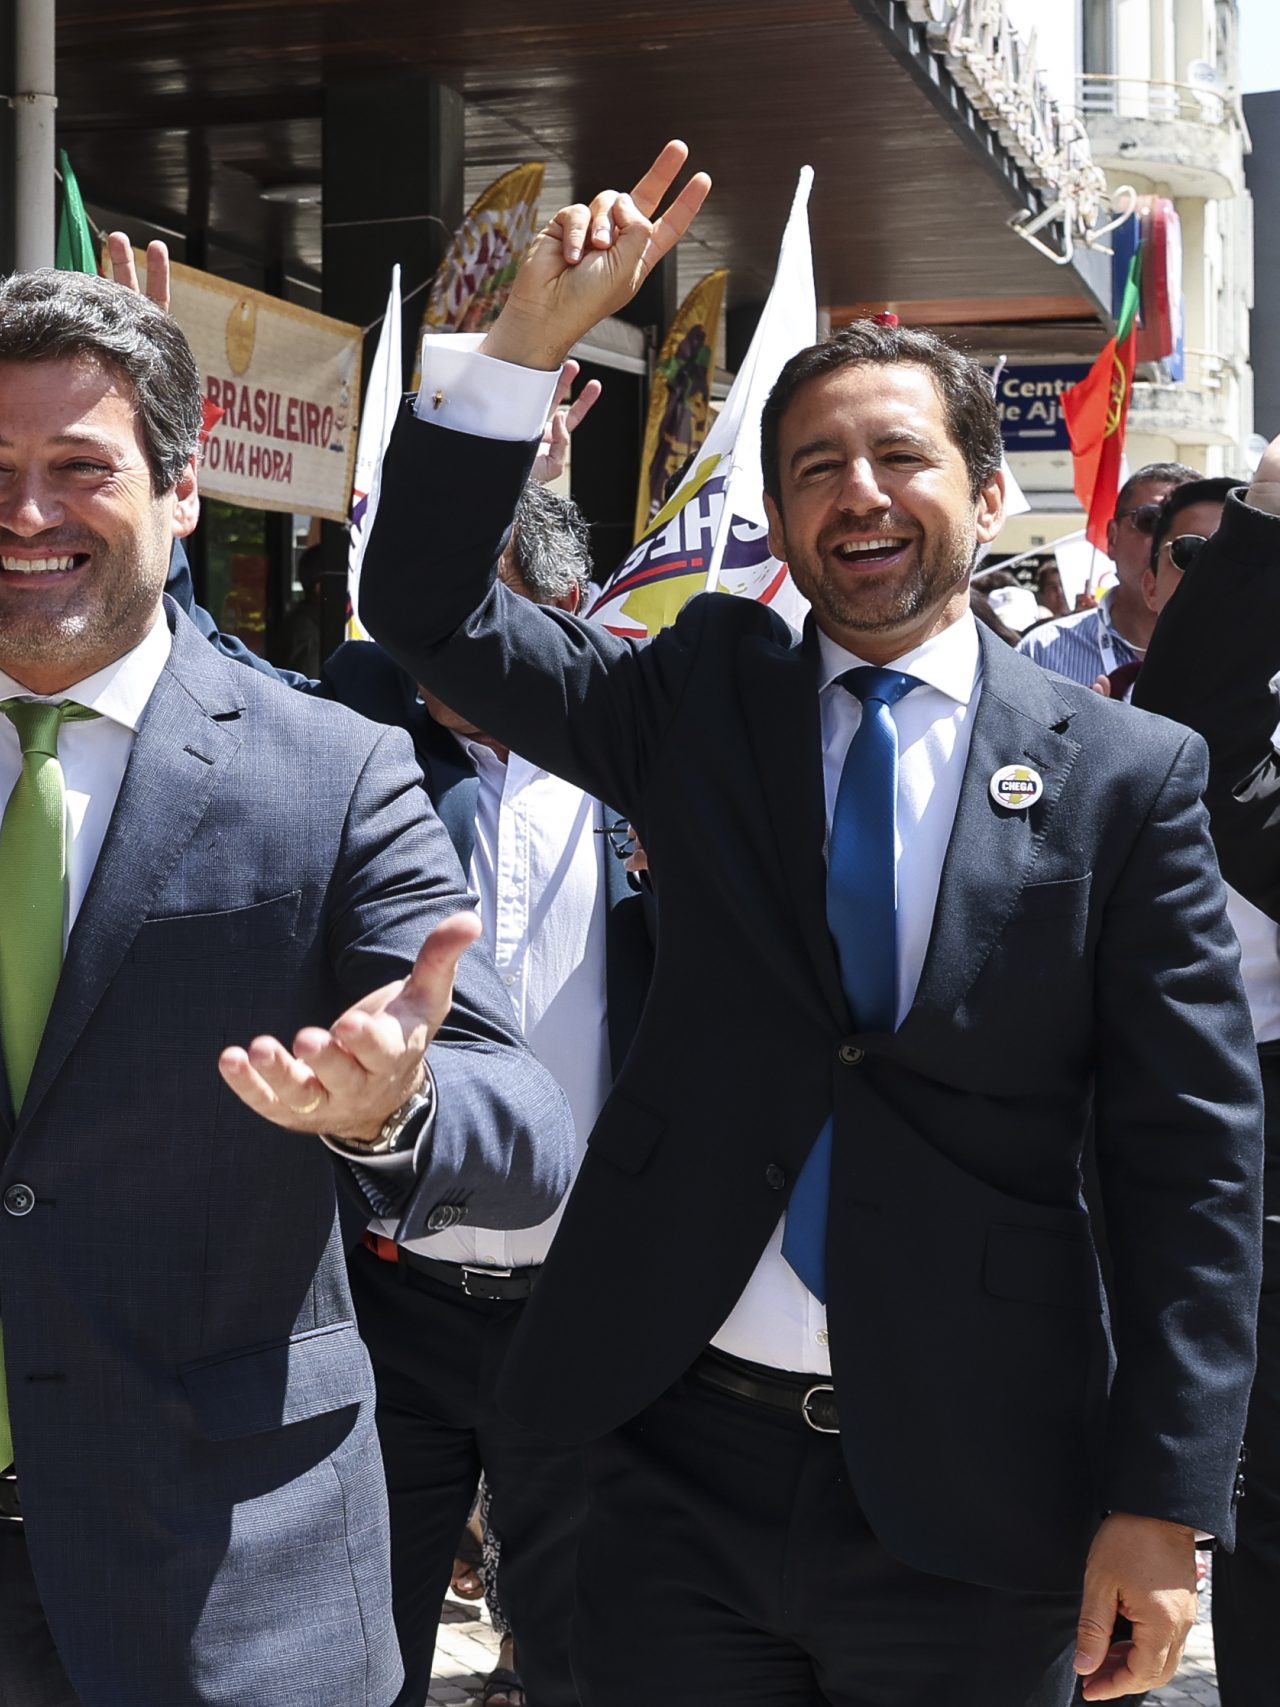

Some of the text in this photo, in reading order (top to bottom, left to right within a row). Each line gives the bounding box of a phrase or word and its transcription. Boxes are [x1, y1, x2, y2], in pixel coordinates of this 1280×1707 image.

[1002, 379, 1076, 398] Centr
[207, 375, 334, 449] BRASILEIRO
[201, 436, 293, 484] TO NA HORA
[1001, 781, 1034, 792] CHEGA
